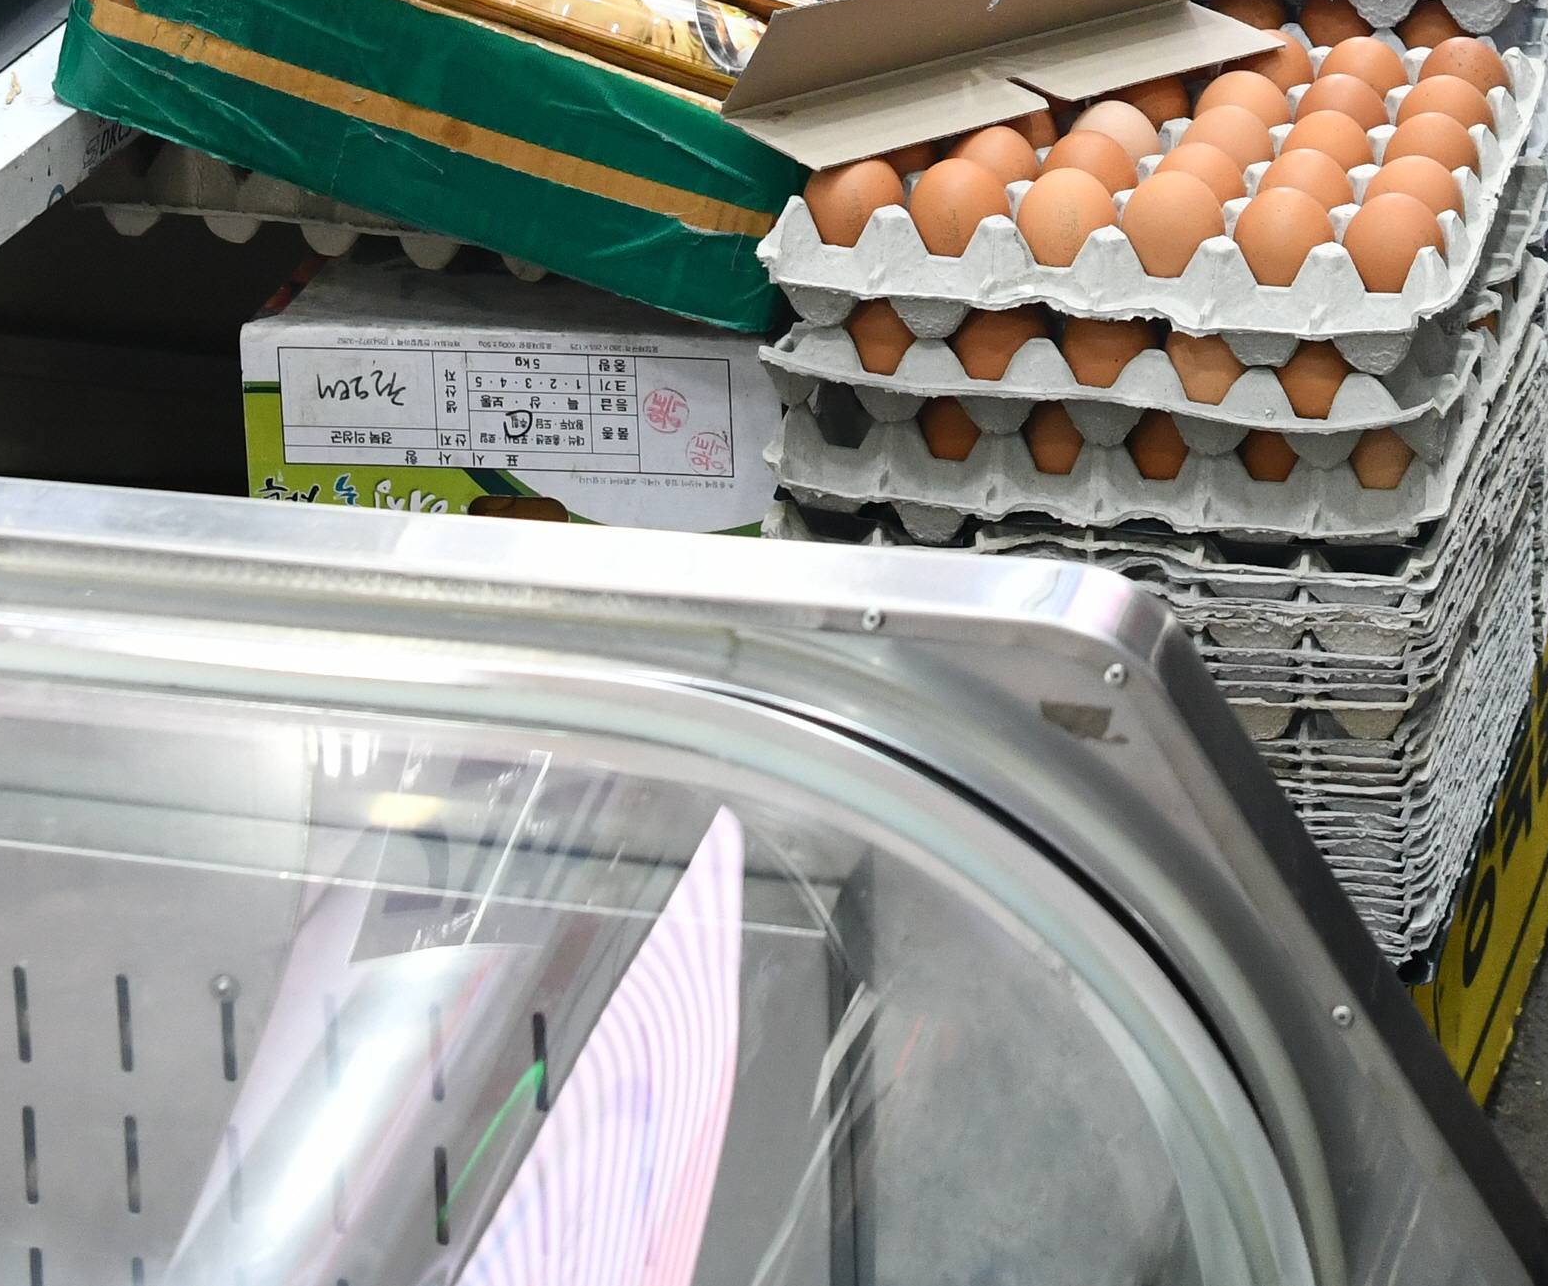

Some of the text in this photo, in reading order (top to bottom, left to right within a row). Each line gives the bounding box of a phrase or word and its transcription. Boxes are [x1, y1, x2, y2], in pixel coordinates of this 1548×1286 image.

[598, 359, 626, 372] 중량
[475, 376, 482, 388] 5
[500, 377, 507, 388] 4
[525, 378, 532, 389] 3
[550, 378, 557, 389] 2
[599, 379, 627, 391] 크기
[444, 369, 458, 414] 생산자
[480, 395, 628, 412] 등급 특 상 보통
[535, 418, 552, 430] 도담
[559, 419, 585, 431] 왕자두
[330, 430, 467, 446] 산지 경북 의성군
[480, 432, 496, 444] 로일
[601, 426, 629, 440] 품종
[568, 435, 585, 446] 대석
